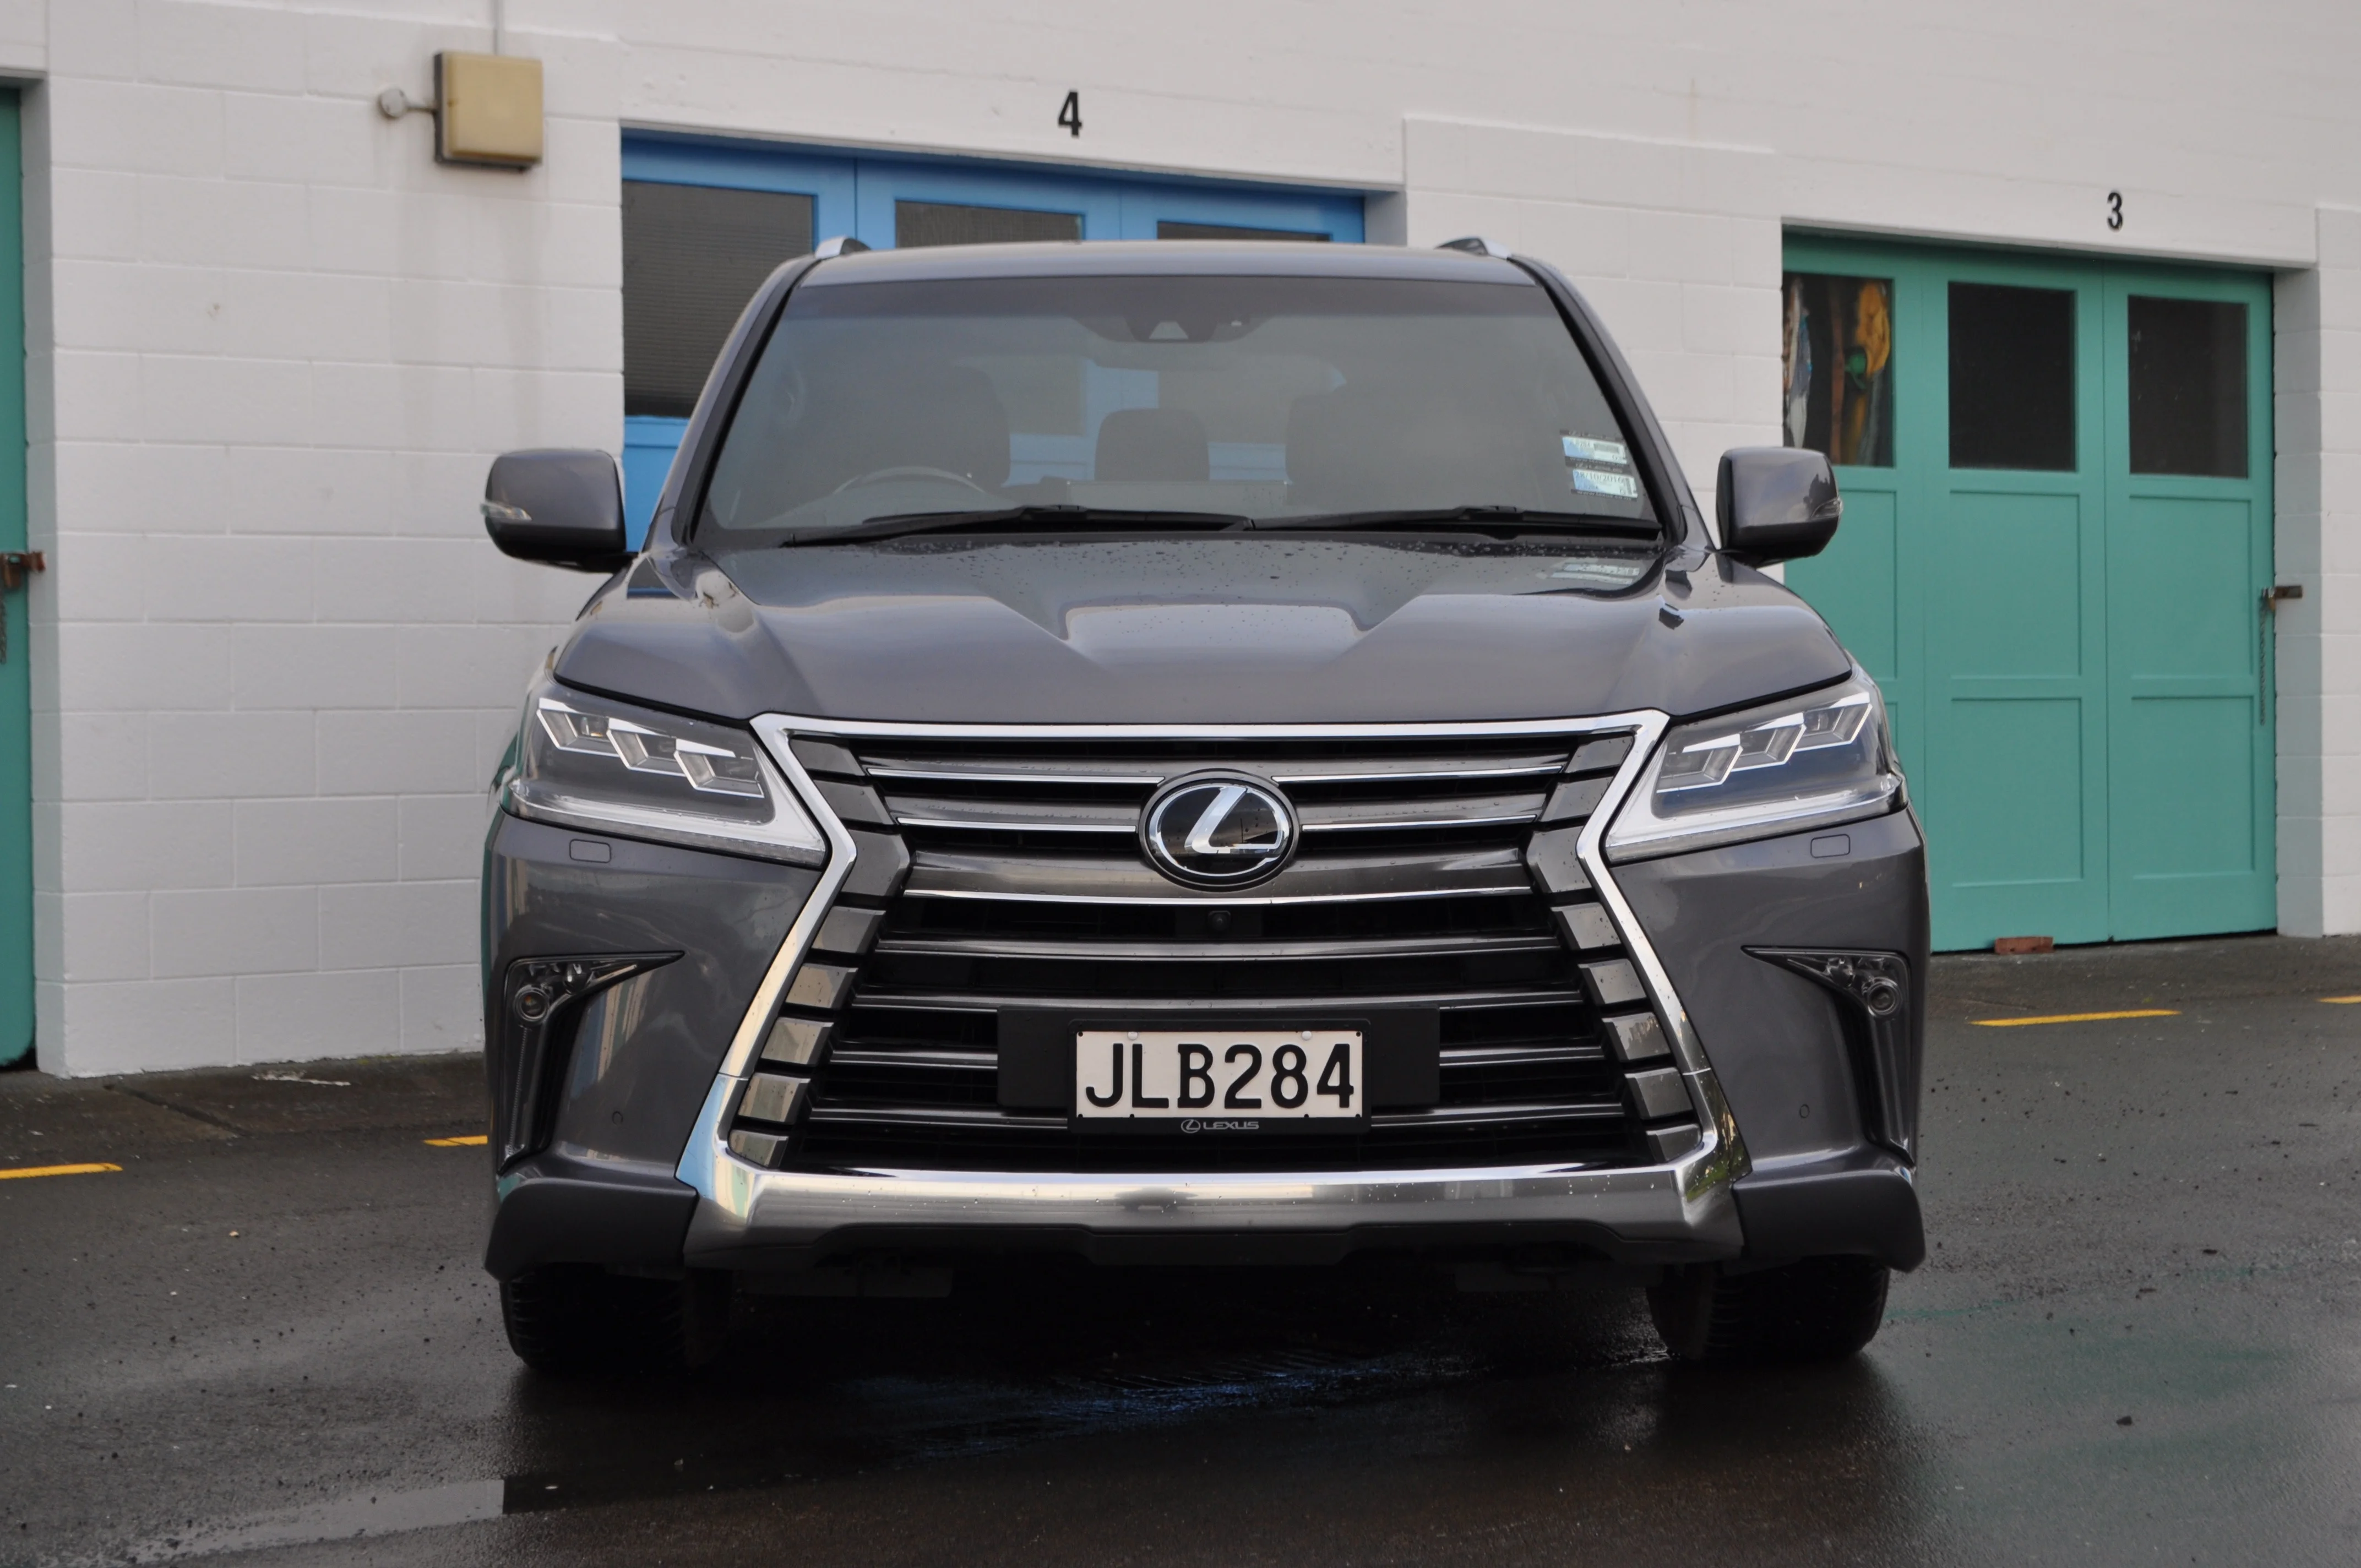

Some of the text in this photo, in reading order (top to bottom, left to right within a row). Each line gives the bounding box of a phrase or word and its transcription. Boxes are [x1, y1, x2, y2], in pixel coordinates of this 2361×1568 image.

[1057, 91, 1082, 137] 4
[2107, 191, 2123, 231] 3
[1085, 1043, 1354, 1109] JLB284
[1203, 1121, 1259, 1130] LEXUS
